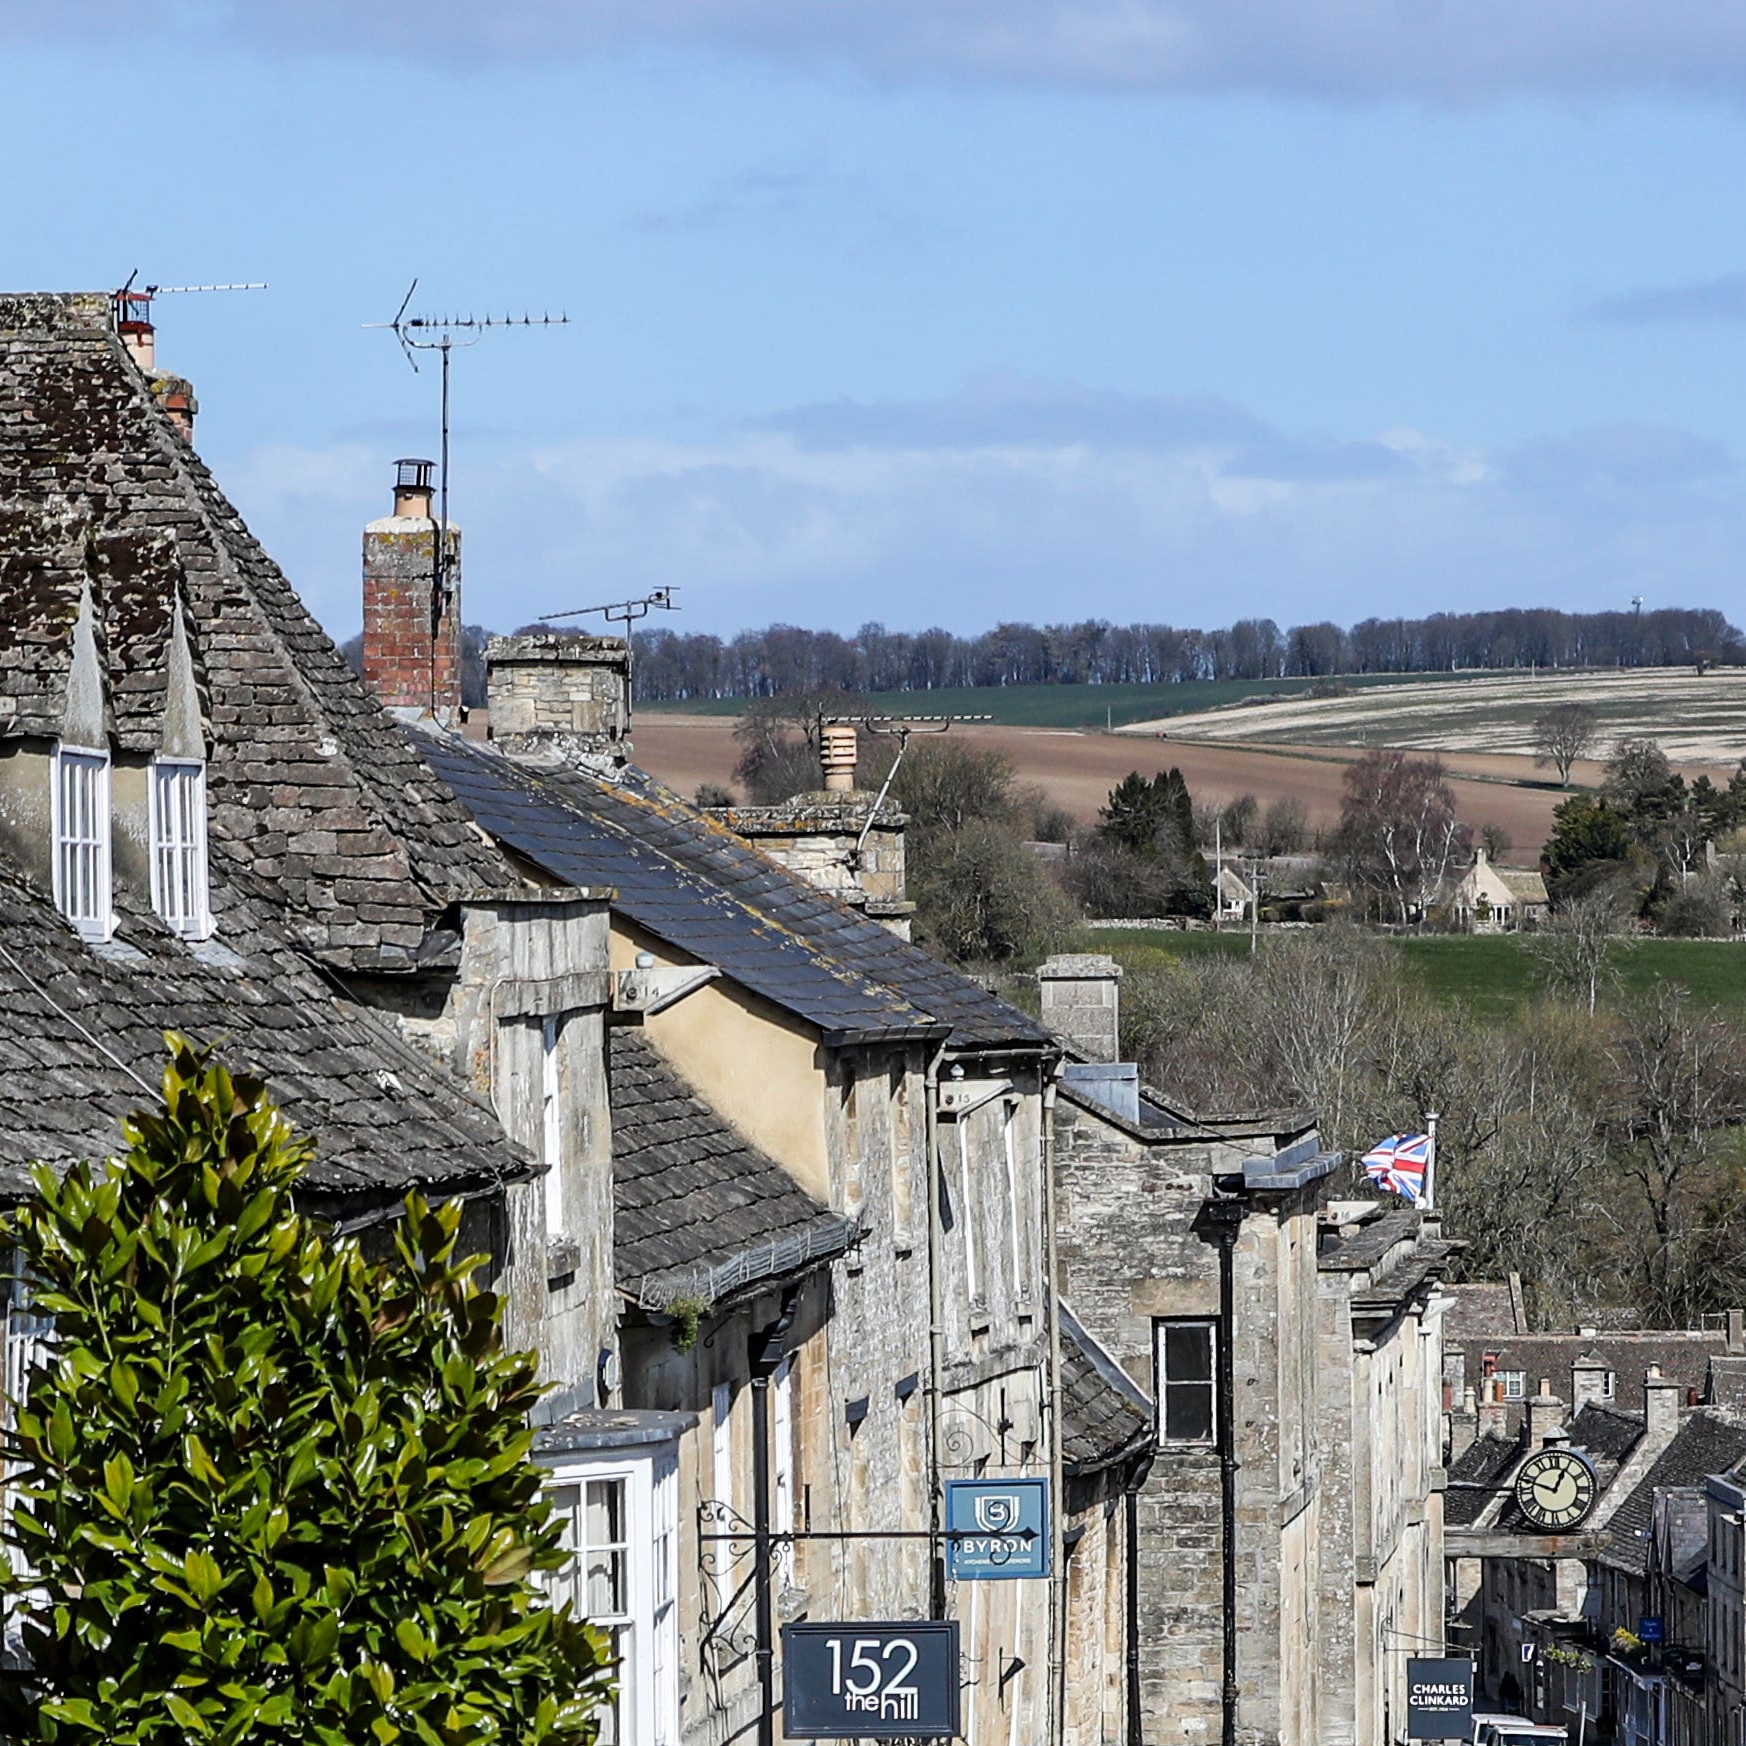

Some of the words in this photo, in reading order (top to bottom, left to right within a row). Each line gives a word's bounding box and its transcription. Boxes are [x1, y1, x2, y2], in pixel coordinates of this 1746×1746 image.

[963, 1539, 1032, 1553] BYRON
[825, 1638, 918, 1696] 152
[1413, 1683, 1466, 1695] CHARLES
[845, 1692, 879, 1711] the
[880, 1693, 918, 1720] hill
[1409, 1695, 1469, 1706] CLINKARD
